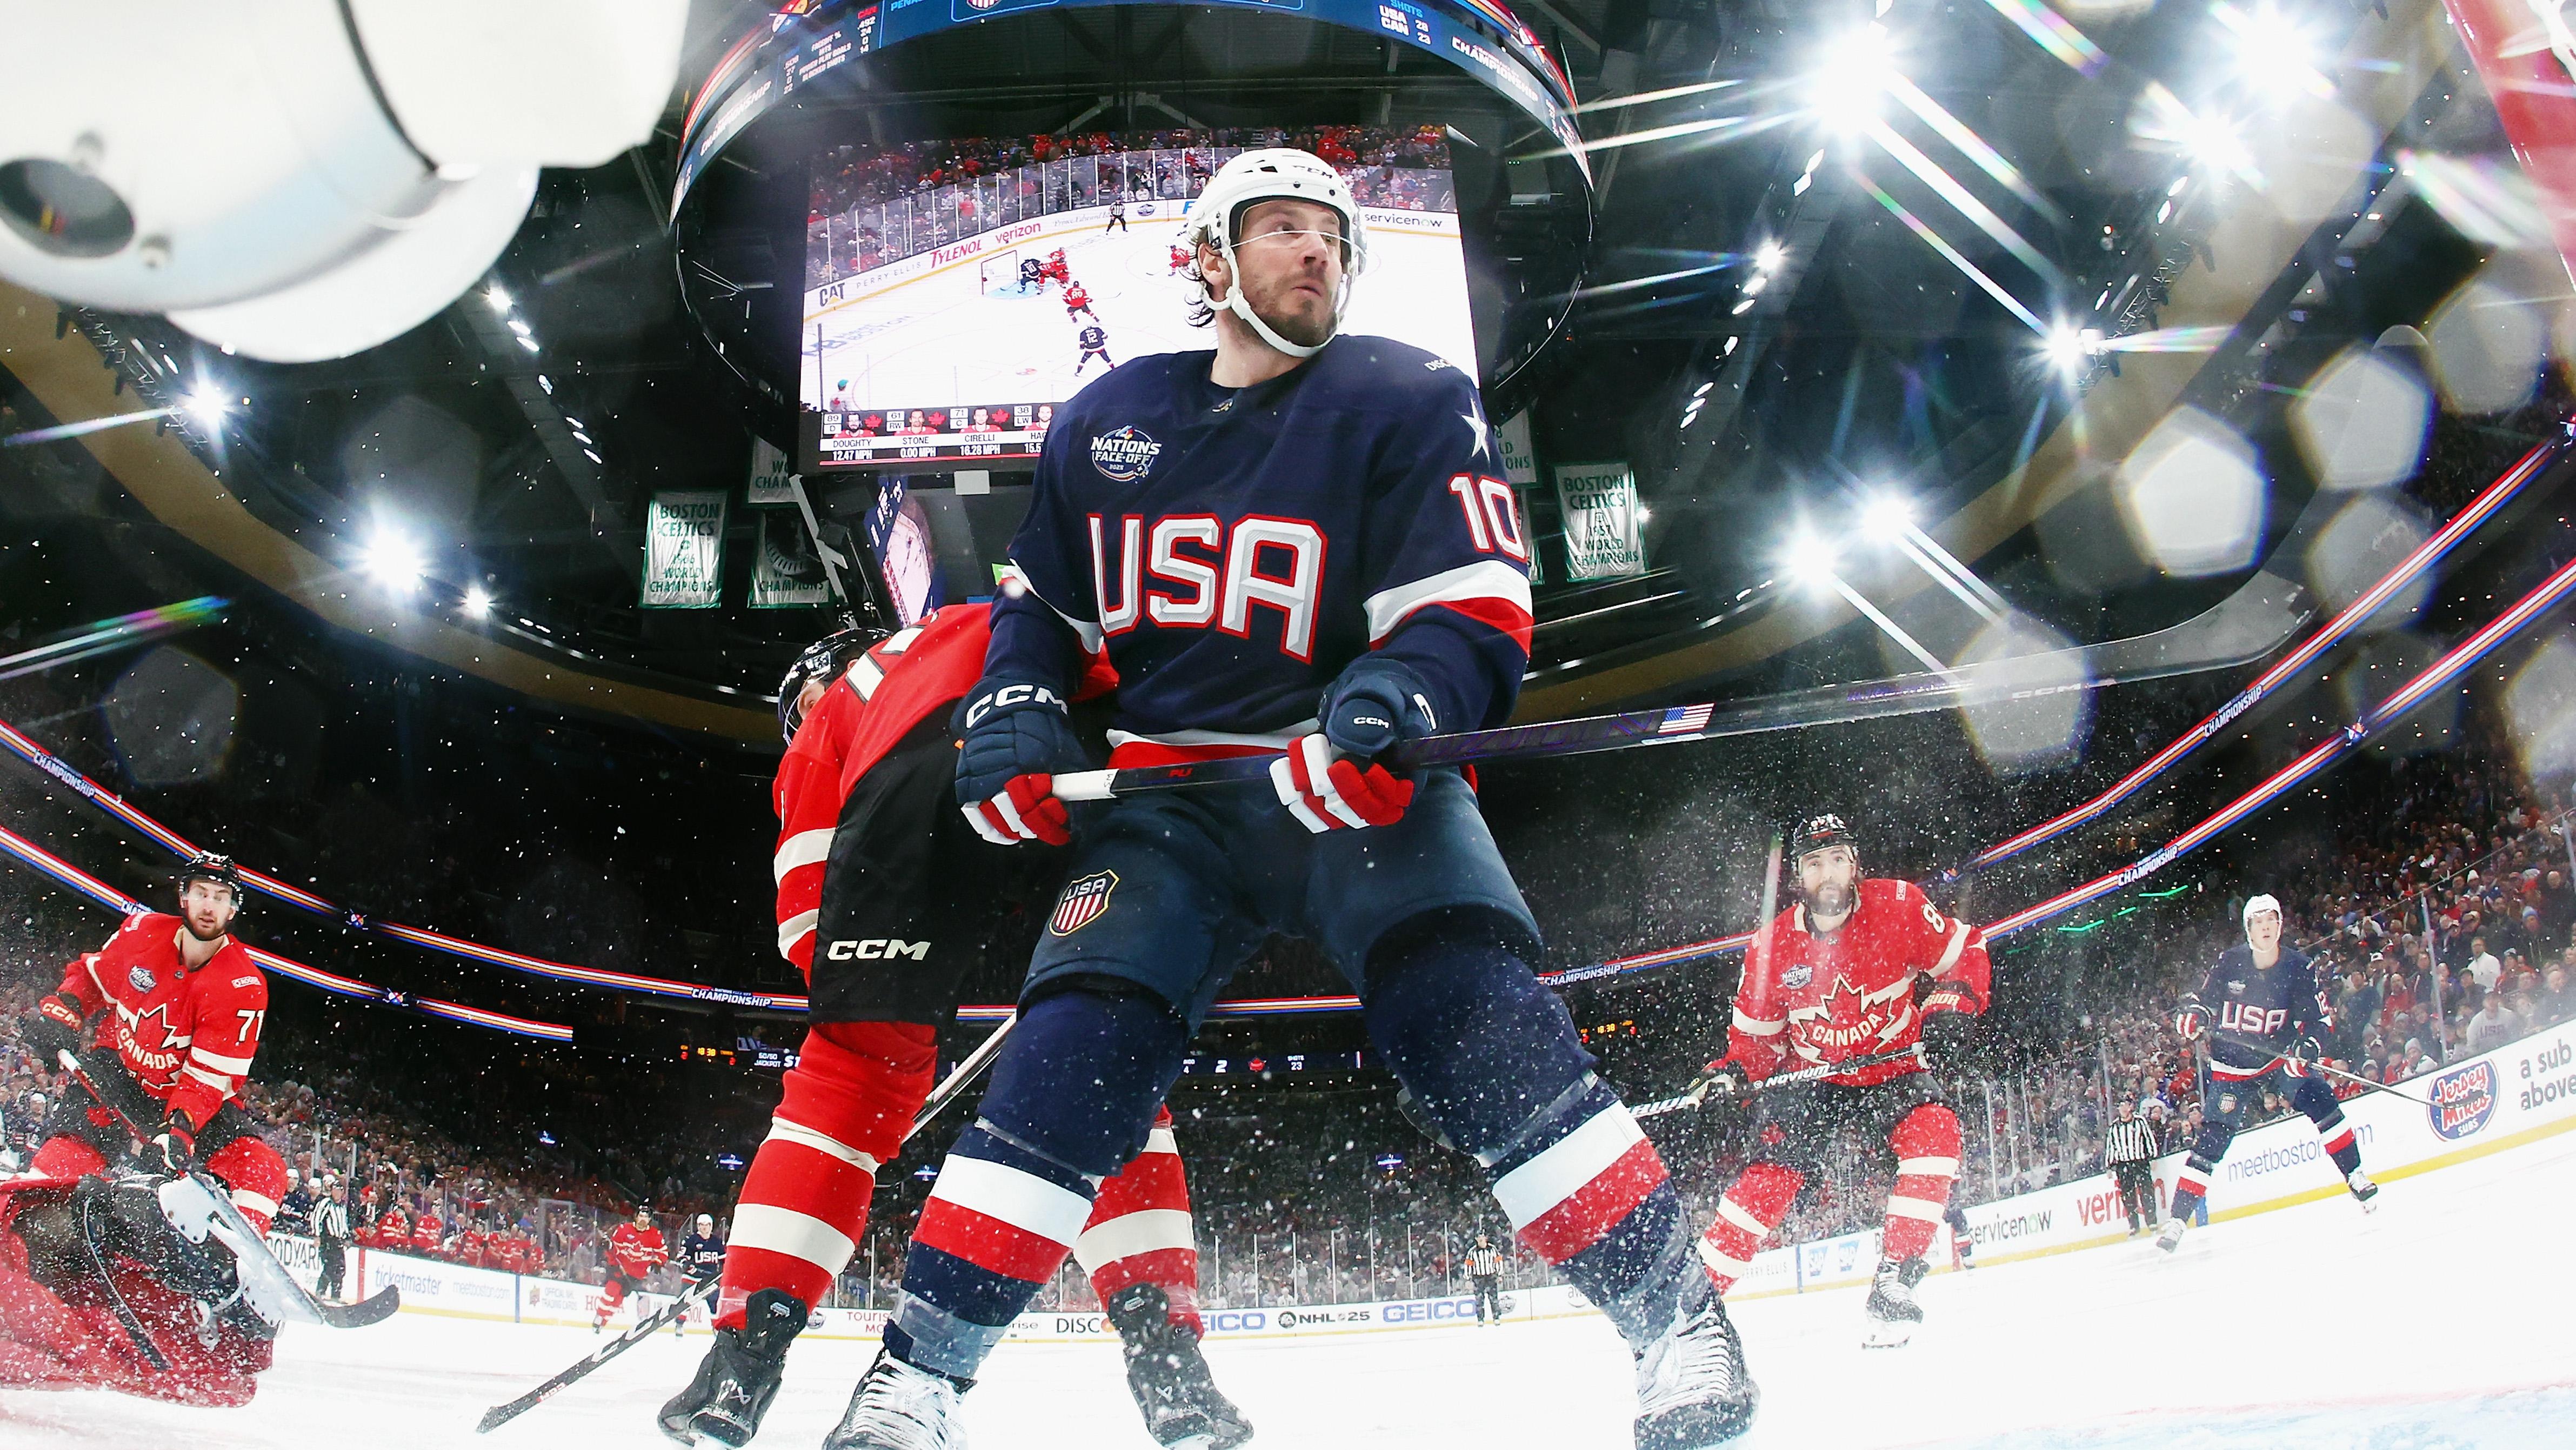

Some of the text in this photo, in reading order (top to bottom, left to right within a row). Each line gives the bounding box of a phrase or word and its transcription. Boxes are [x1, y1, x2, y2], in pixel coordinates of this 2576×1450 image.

[1379, 5, 1429, 32] USA 28
[1391, 0, 1424, 18] SHOTS
[857, 16, 876, 30] .492
[1380, 17, 1432, 45] CAN 23
[1451, 36, 1539, 103] CHAMPIONSHIP
[700, 80, 772, 157] CHAMPIONSHIP
[1365, 212, 1443, 229] servicenow
[819, 282, 846, 308] CAT
[856, 272, 889, 290] PERRY
[893, 261, 922, 277] ELLIS
[929, 240, 983, 269] TYLENOL
[995, 222, 1042, 244] verizon
[1086, 331, 1098, 344] 12
[955, 409, 966, 417] 71
[833, 439, 872, 448] DOUGHTY
[902, 436, 929, 445] STONE
[965, 434, 996, 442] CIRELLI
[1090, 436, 1163, 455] NATIONS
[832, 449, 873, 461] 12.47 MPH
[900, 447, 936, 458] 0.00 MPH
[960, 444, 1000, 456] 16.28 MPH
[1024, 443, 1043, 453] 15.5
[1564, 474, 1623, 493] BOSTON
[1570, 492, 1626, 510] CELTICS
[659, 503, 719, 520] BOSTON
[1447, 471, 1529, 563] 10
[659, 521, 716, 537] CELTICS
[1585, 538, 1623, 550] WORLD
[1575, 550, 1639, 566] CHAMPIONS
[663, 567, 703, 578] WORLD
[649, 580, 713, 593] CHAMPIONS
[758, 580, 824, 593] CHAMPIONS
[1086, 513, 1328, 666] USA
[966, 684, 1069, 729] CCM
[2204, 685, 2263, 737] CHAMPIONSHIP
[1353, 716, 1390, 729] CCM
[33, 750, 96, 797] CHAMPIONSHIP
[2118, 846, 2178, 887] CHAMPIONSHIP
[1065, 877, 1107, 901] USA
[827, 939, 931, 961] CCM
[1544, 964, 1621, 986] CHAMPIONSHIP
[692, 988, 772, 1007] CHAMPIONSHIP
[42, 1002, 82, 1029] CCM
[2220, 1000, 2289, 1034] USA
[236, 1009, 265, 1042] 71
[1812, 1013, 1883, 1048] CANADA
[119, 1027, 180, 1070] CANADA
[754, 1060, 782, 1068] JACKPOT
[1215, 1060, 1228, 1073] 2
[1291, 1062, 1303, 1070] 23
[2520, 1039, 2572, 1079] a sub
[1765, 1065, 1831, 1088] NOVIUM
[2435, 1064, 2488, 1103] Jersey
[2520, 1074, 2576, 1111] above
[2228, 1123, 2374, 1182] meetbostom
[1969, 1209, 2052, 1246] servicenow
[695, 1251, 719, 1264] USA
[375, 1265, 442, 1295] ticketmaster
[1743, 1261, 1787, 1280] ERRY ELLIS
[847, 1312, 892, 1322] TOURIS
[1299, 1311, 1371, 1325] NHL 25
[1383, 1299, 1477, 1323] GEICO
[1199, 1313, 1266, 1332] EICO
